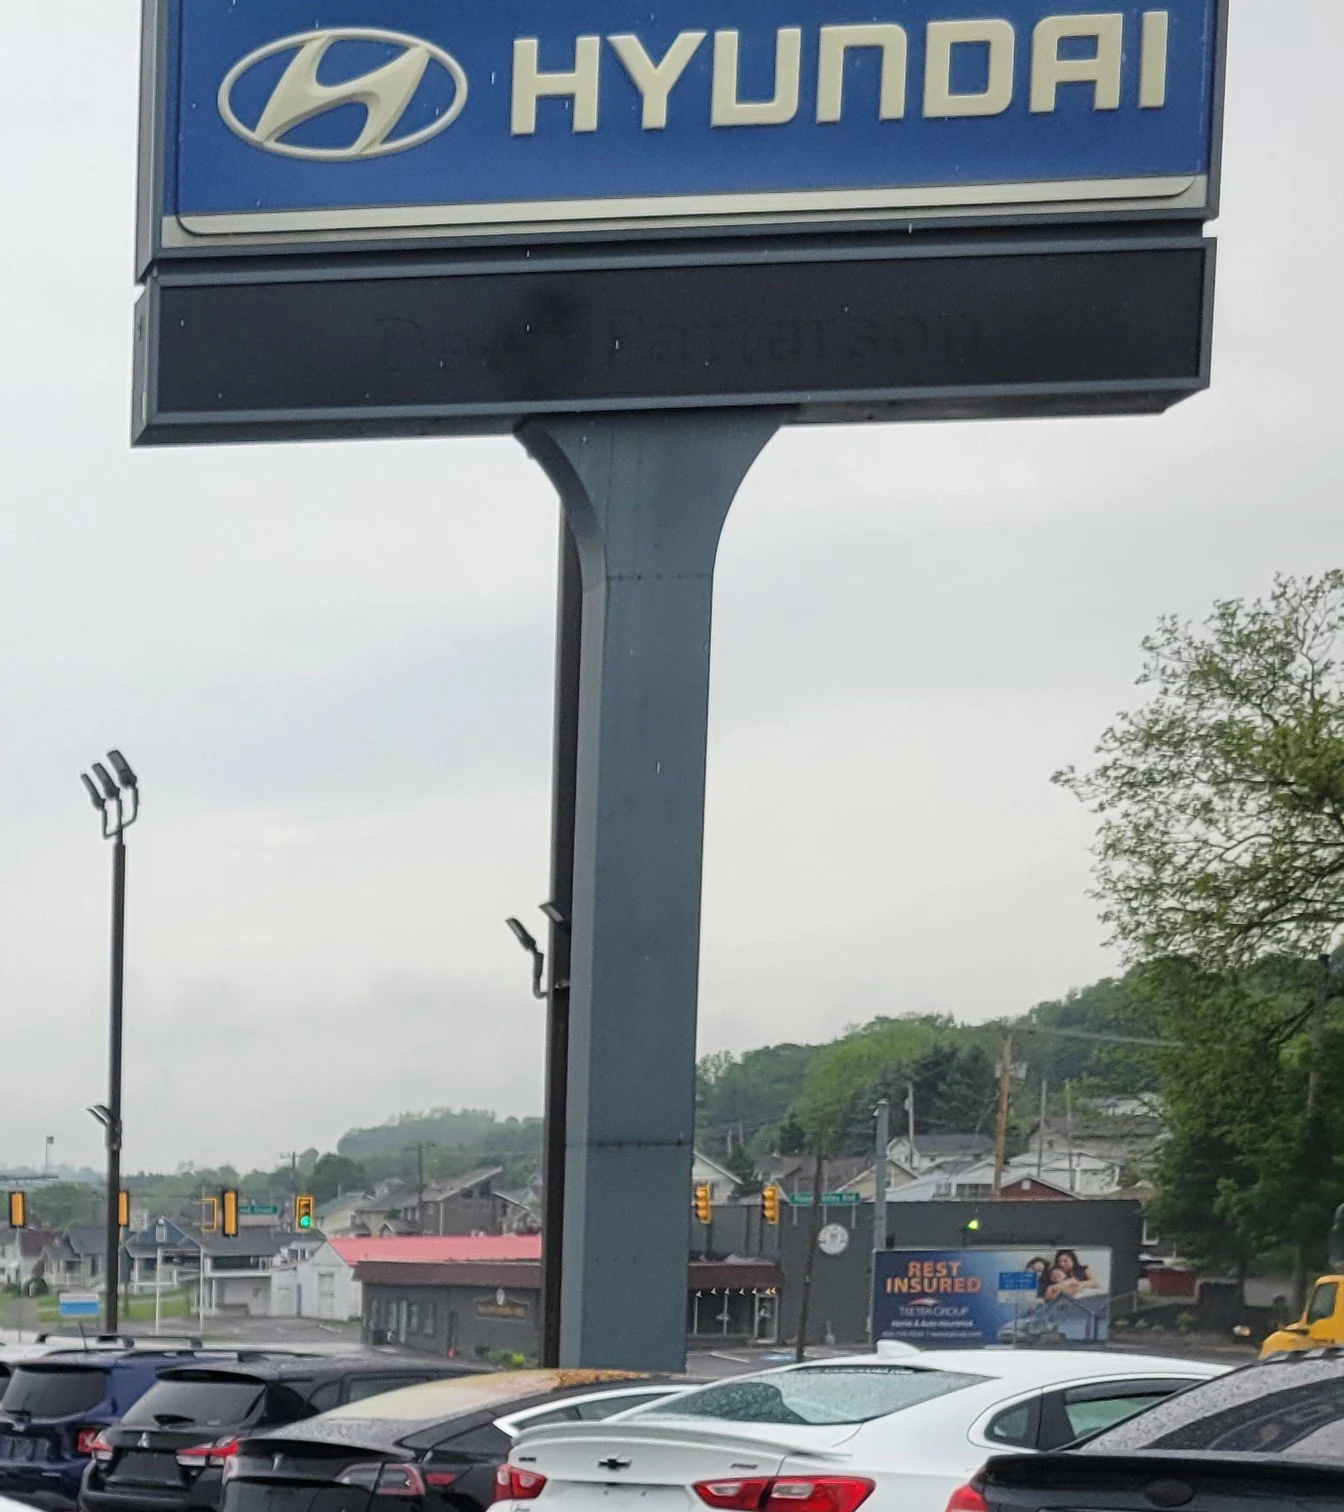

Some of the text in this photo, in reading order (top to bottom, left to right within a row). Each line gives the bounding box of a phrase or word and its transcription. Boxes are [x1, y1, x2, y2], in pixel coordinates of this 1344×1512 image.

[510, 10, 1169, 136] HYUNDAI
[907, 1259, 962, 1277] REST
[885, 1276, 983, 1294] INSURED
